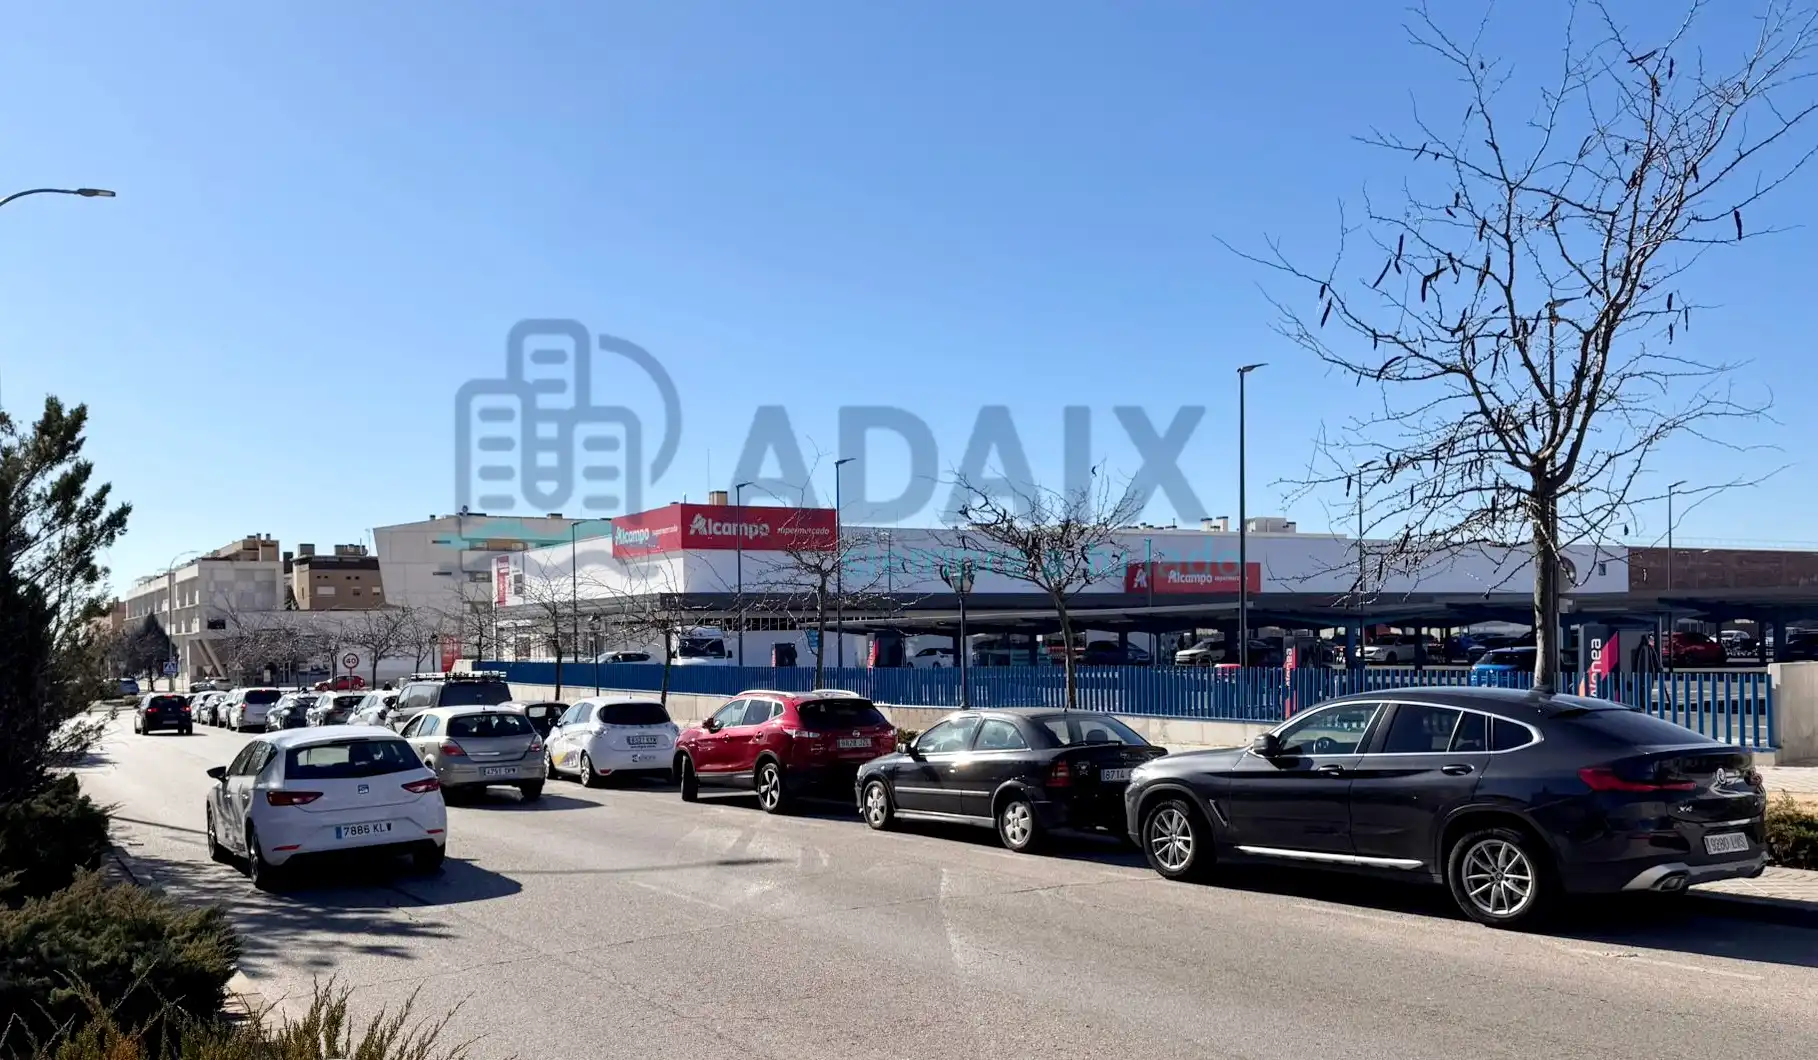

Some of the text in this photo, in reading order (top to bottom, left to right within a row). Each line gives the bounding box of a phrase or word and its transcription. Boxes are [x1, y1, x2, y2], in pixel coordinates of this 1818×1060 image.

[689, 513, 769, 539] Alcampo
[615, 526, 650, 546] Alcampo
[1168, 570, 1213, 585] Alcampo
[343, 825, 371, 837] 7886
